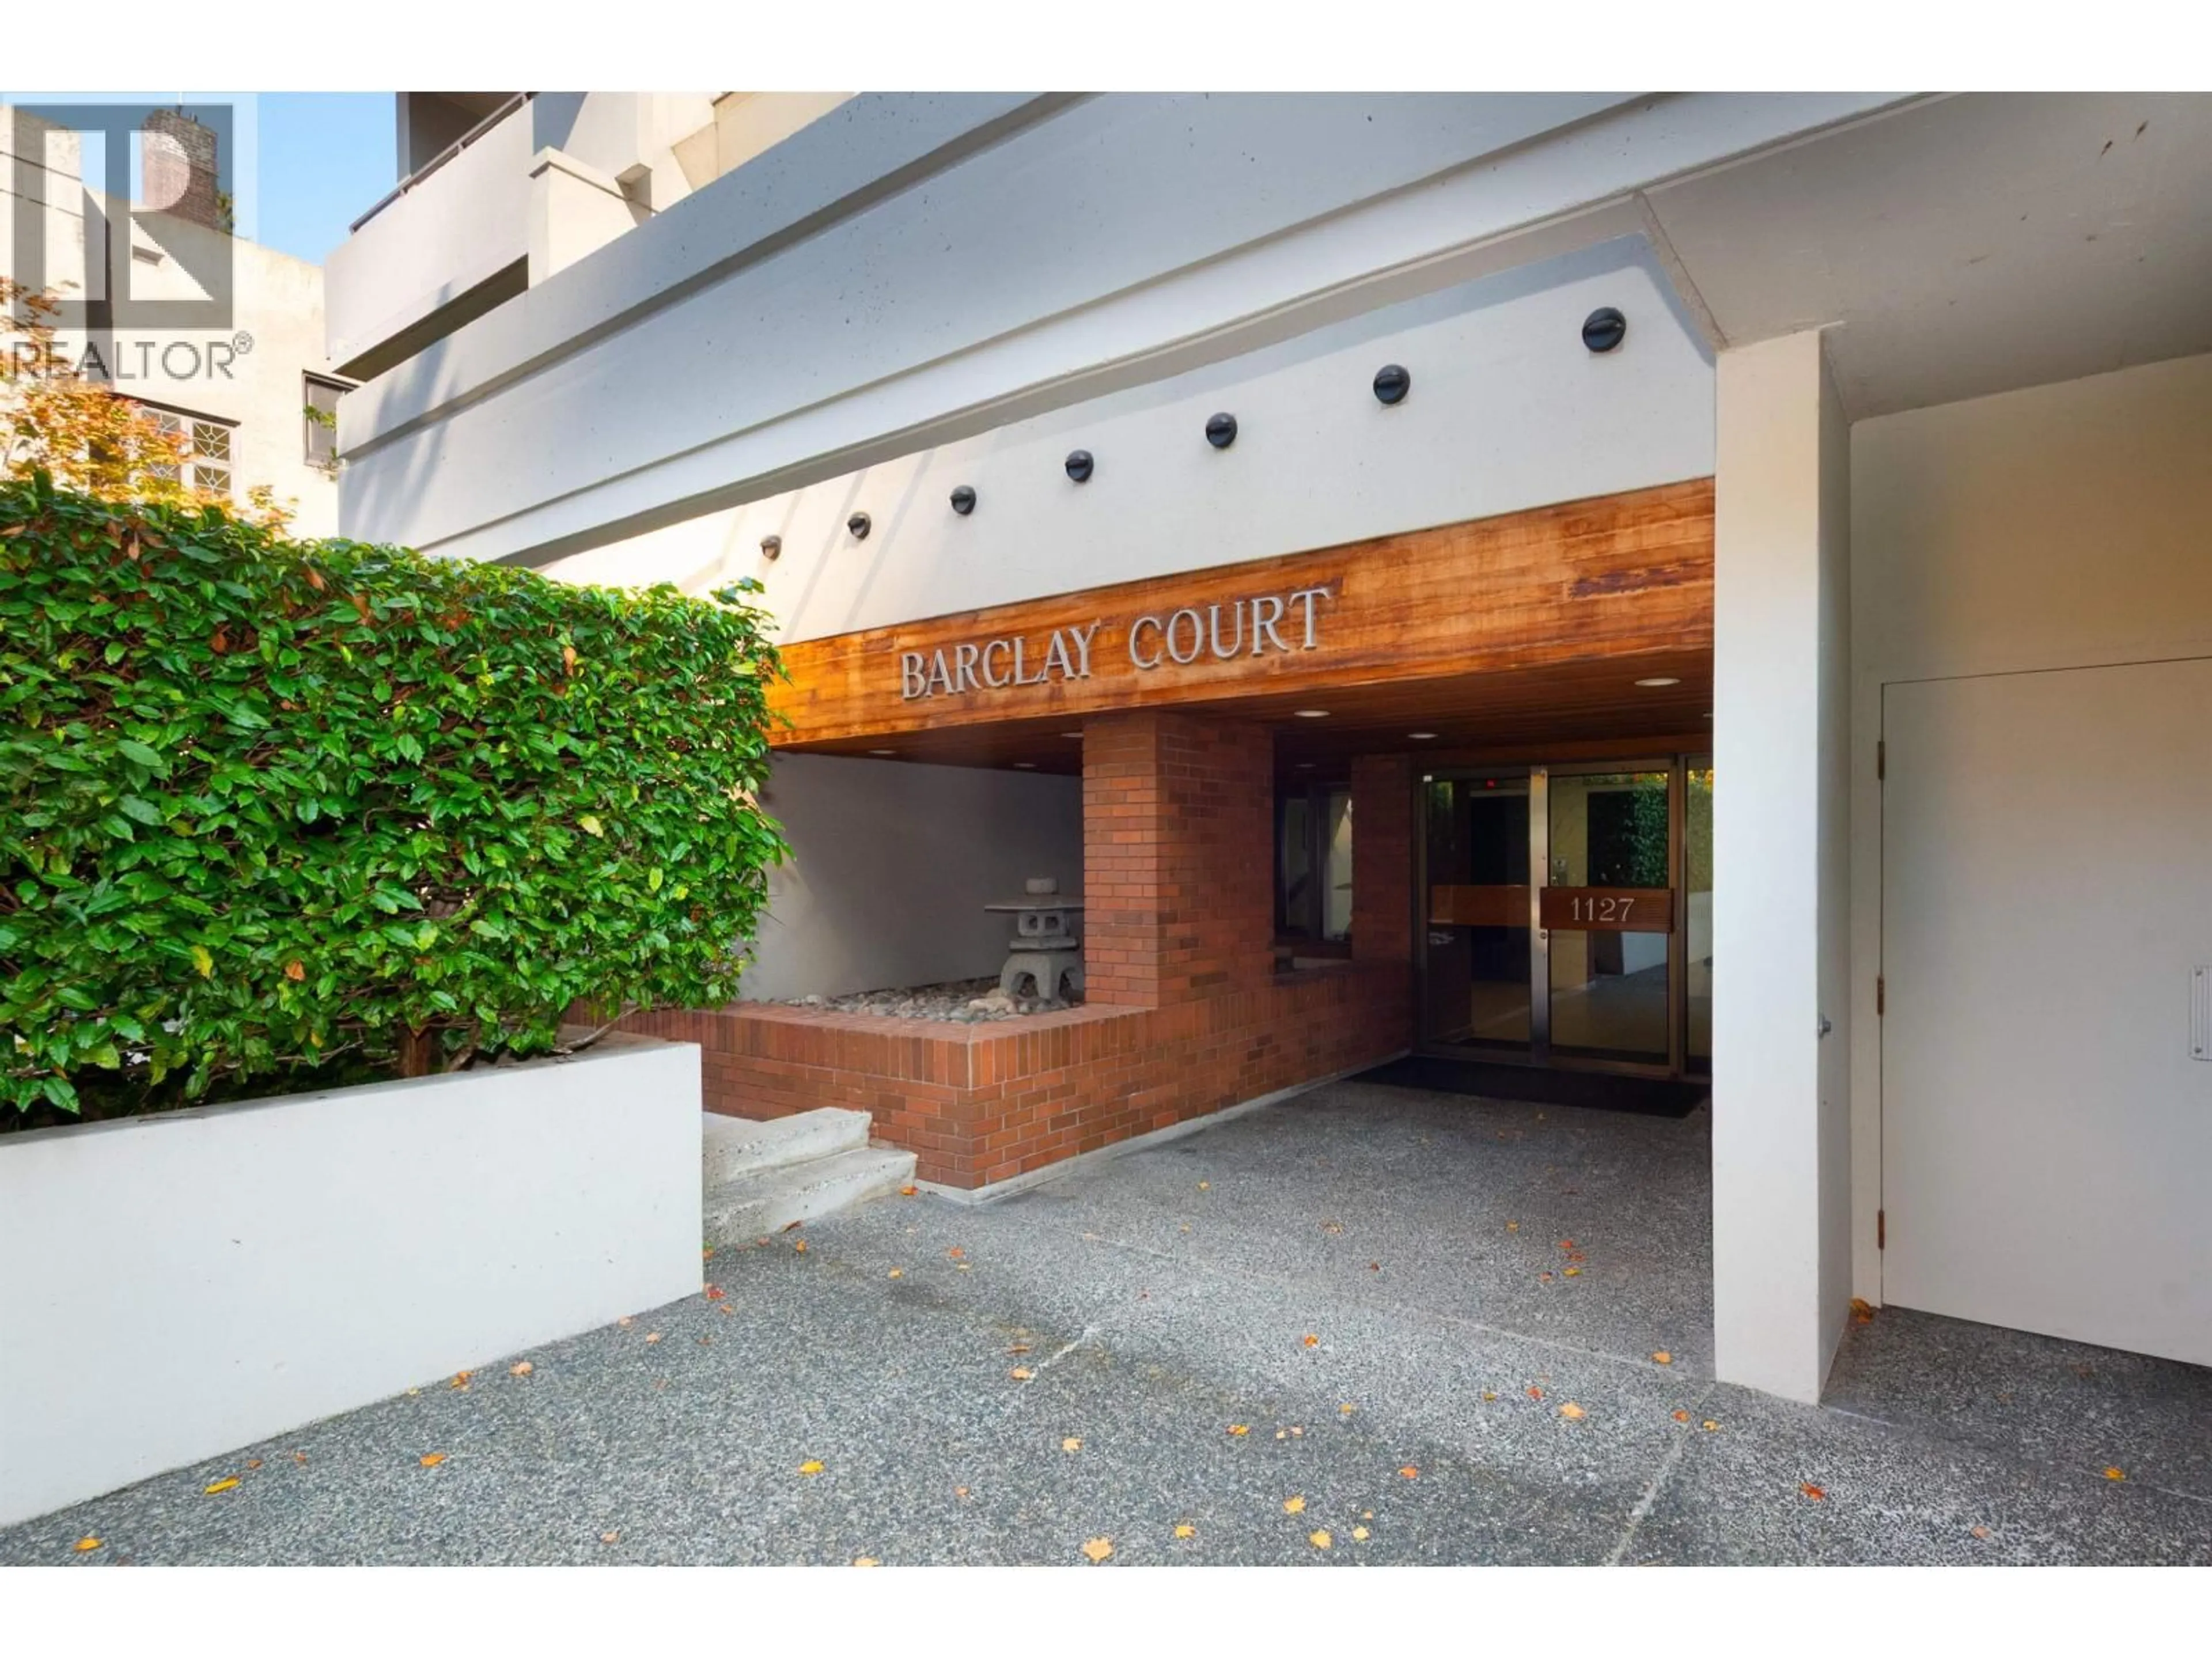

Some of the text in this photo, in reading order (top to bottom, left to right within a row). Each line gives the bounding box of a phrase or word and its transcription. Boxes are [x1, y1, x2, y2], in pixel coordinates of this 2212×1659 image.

[901, 588, 1332, 700] BARCLAY COURT
[1571, 897, 1635, 922] 1127
